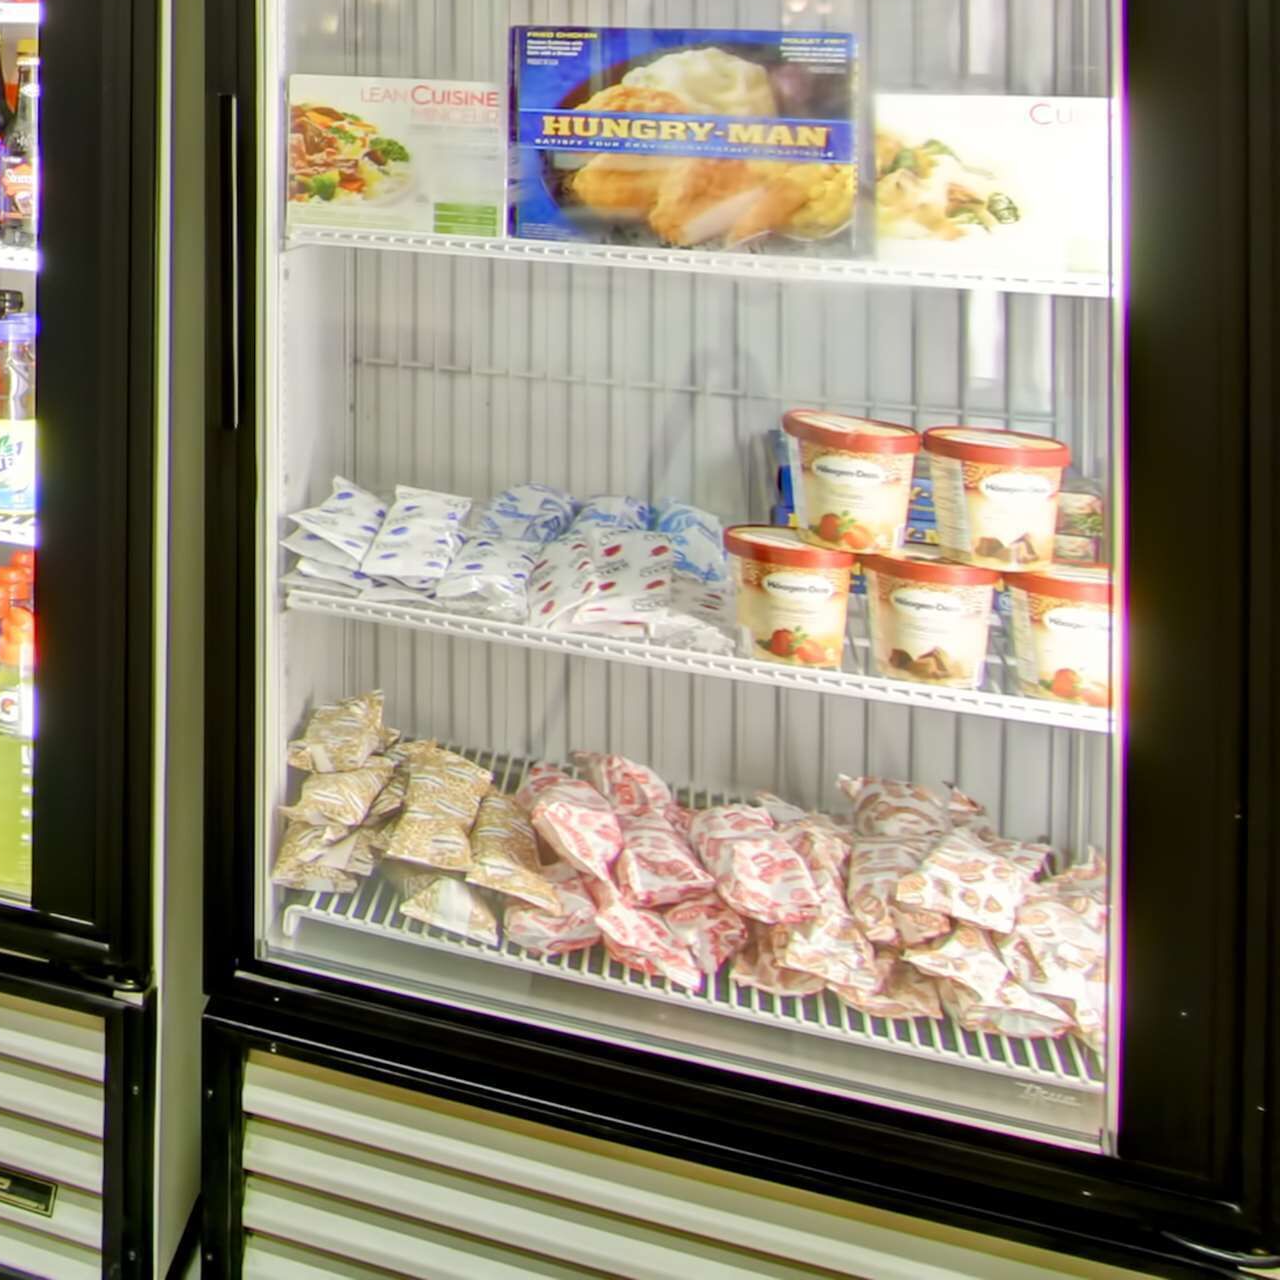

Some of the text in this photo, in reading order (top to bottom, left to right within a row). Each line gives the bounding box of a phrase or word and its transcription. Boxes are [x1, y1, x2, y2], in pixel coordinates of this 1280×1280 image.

[360, 84, 500, 108] LEAN CUISINE
[541, 114, 831, 148] HUNGRY-MAN
